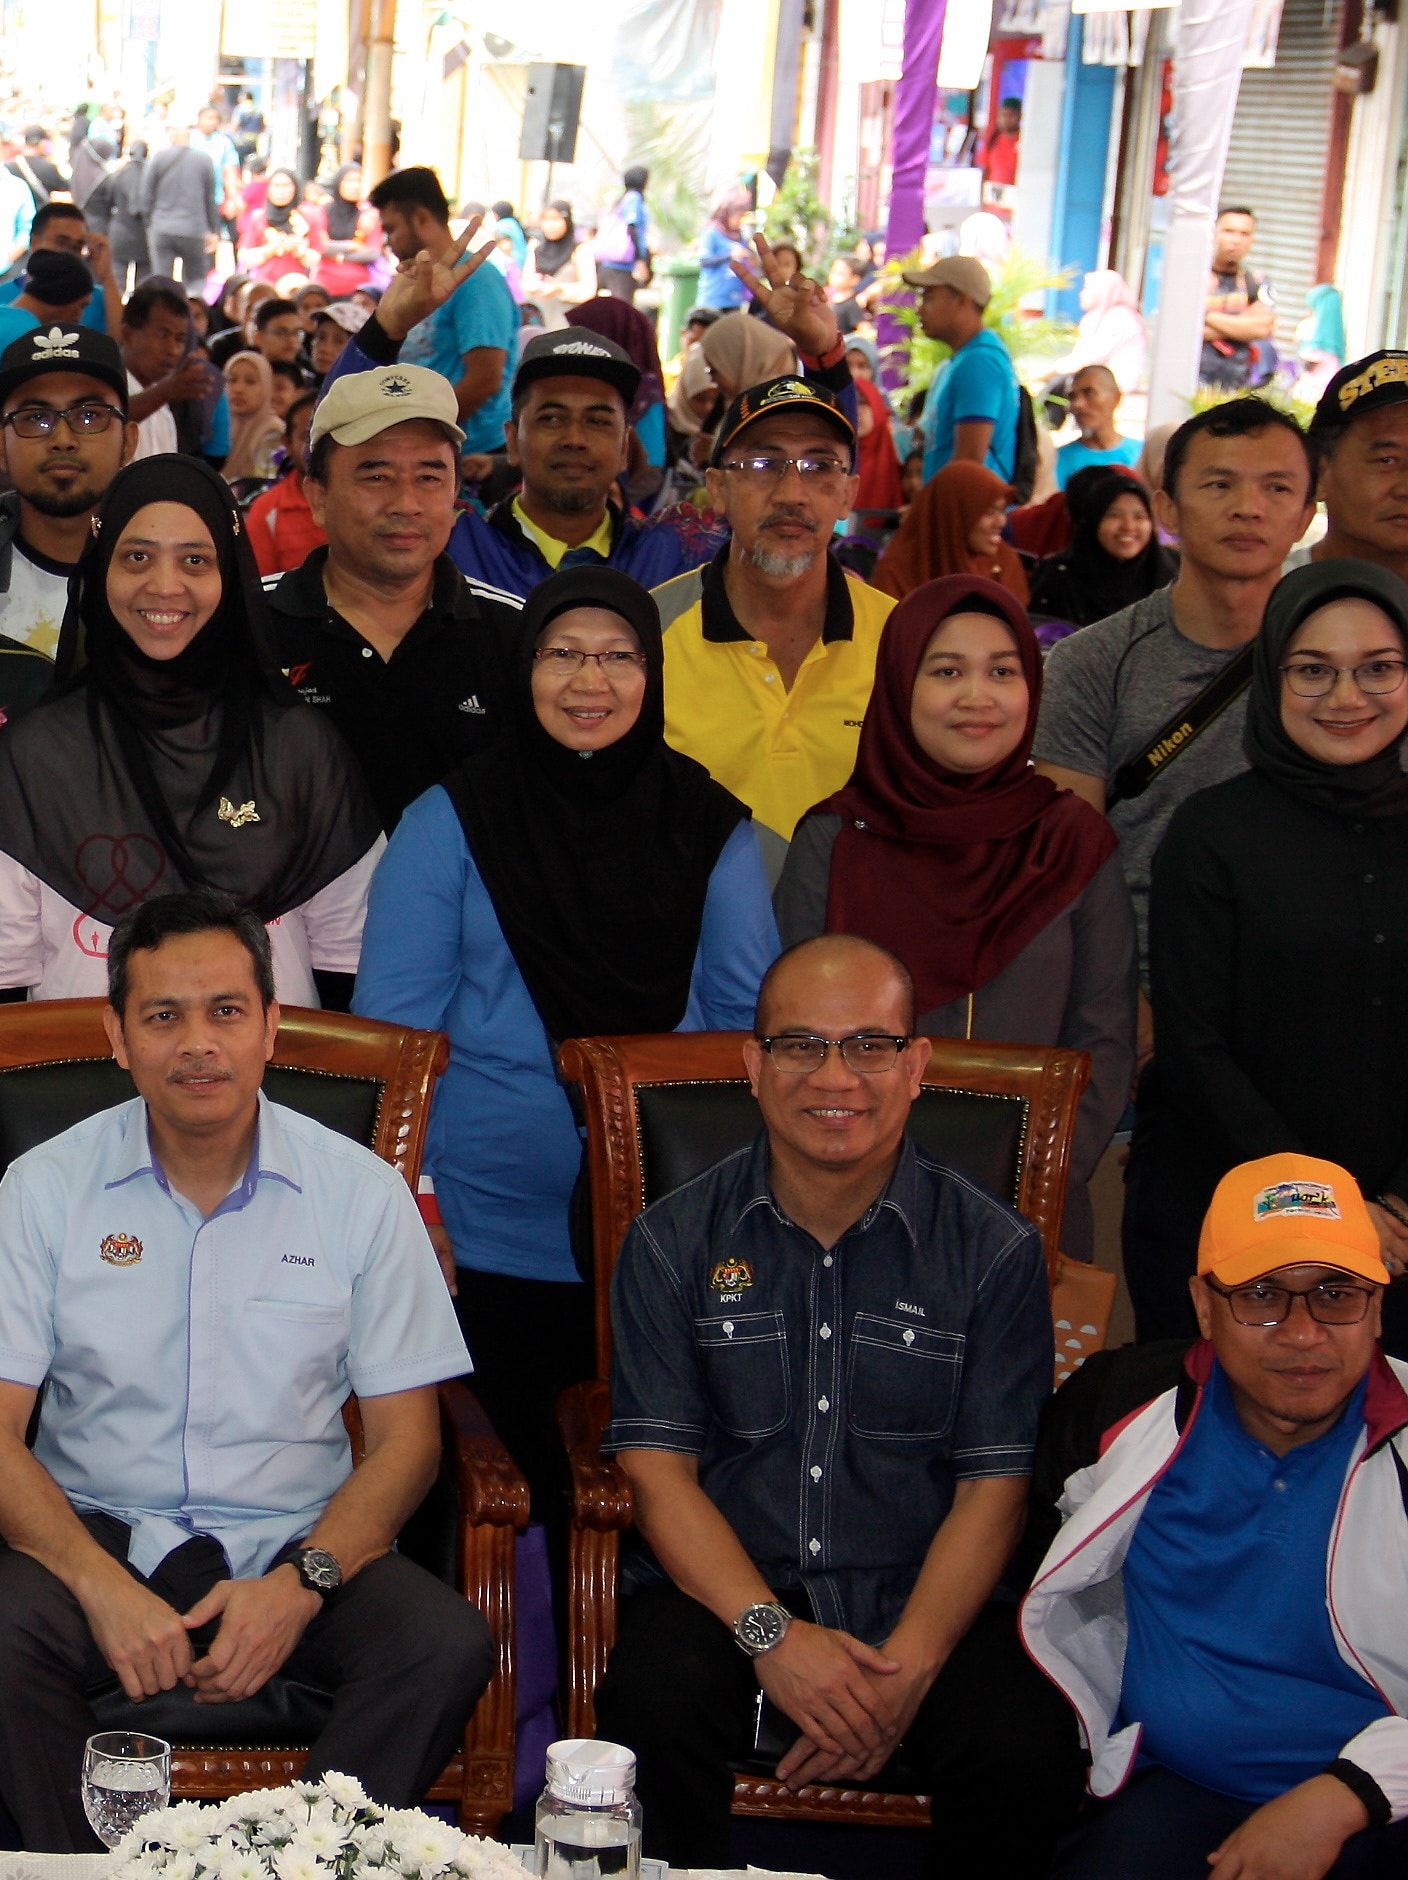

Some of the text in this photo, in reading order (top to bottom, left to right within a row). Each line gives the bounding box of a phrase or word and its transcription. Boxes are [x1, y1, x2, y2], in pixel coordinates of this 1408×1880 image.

[32, 348, 80, 361] adidas
[458, 703, 486, 715] adidas
[1147, 722, 1193, 767] Nikon
[281, 1253, 315, 1267] AZHAR
[720, 1293, 743, 1303] KPKT
